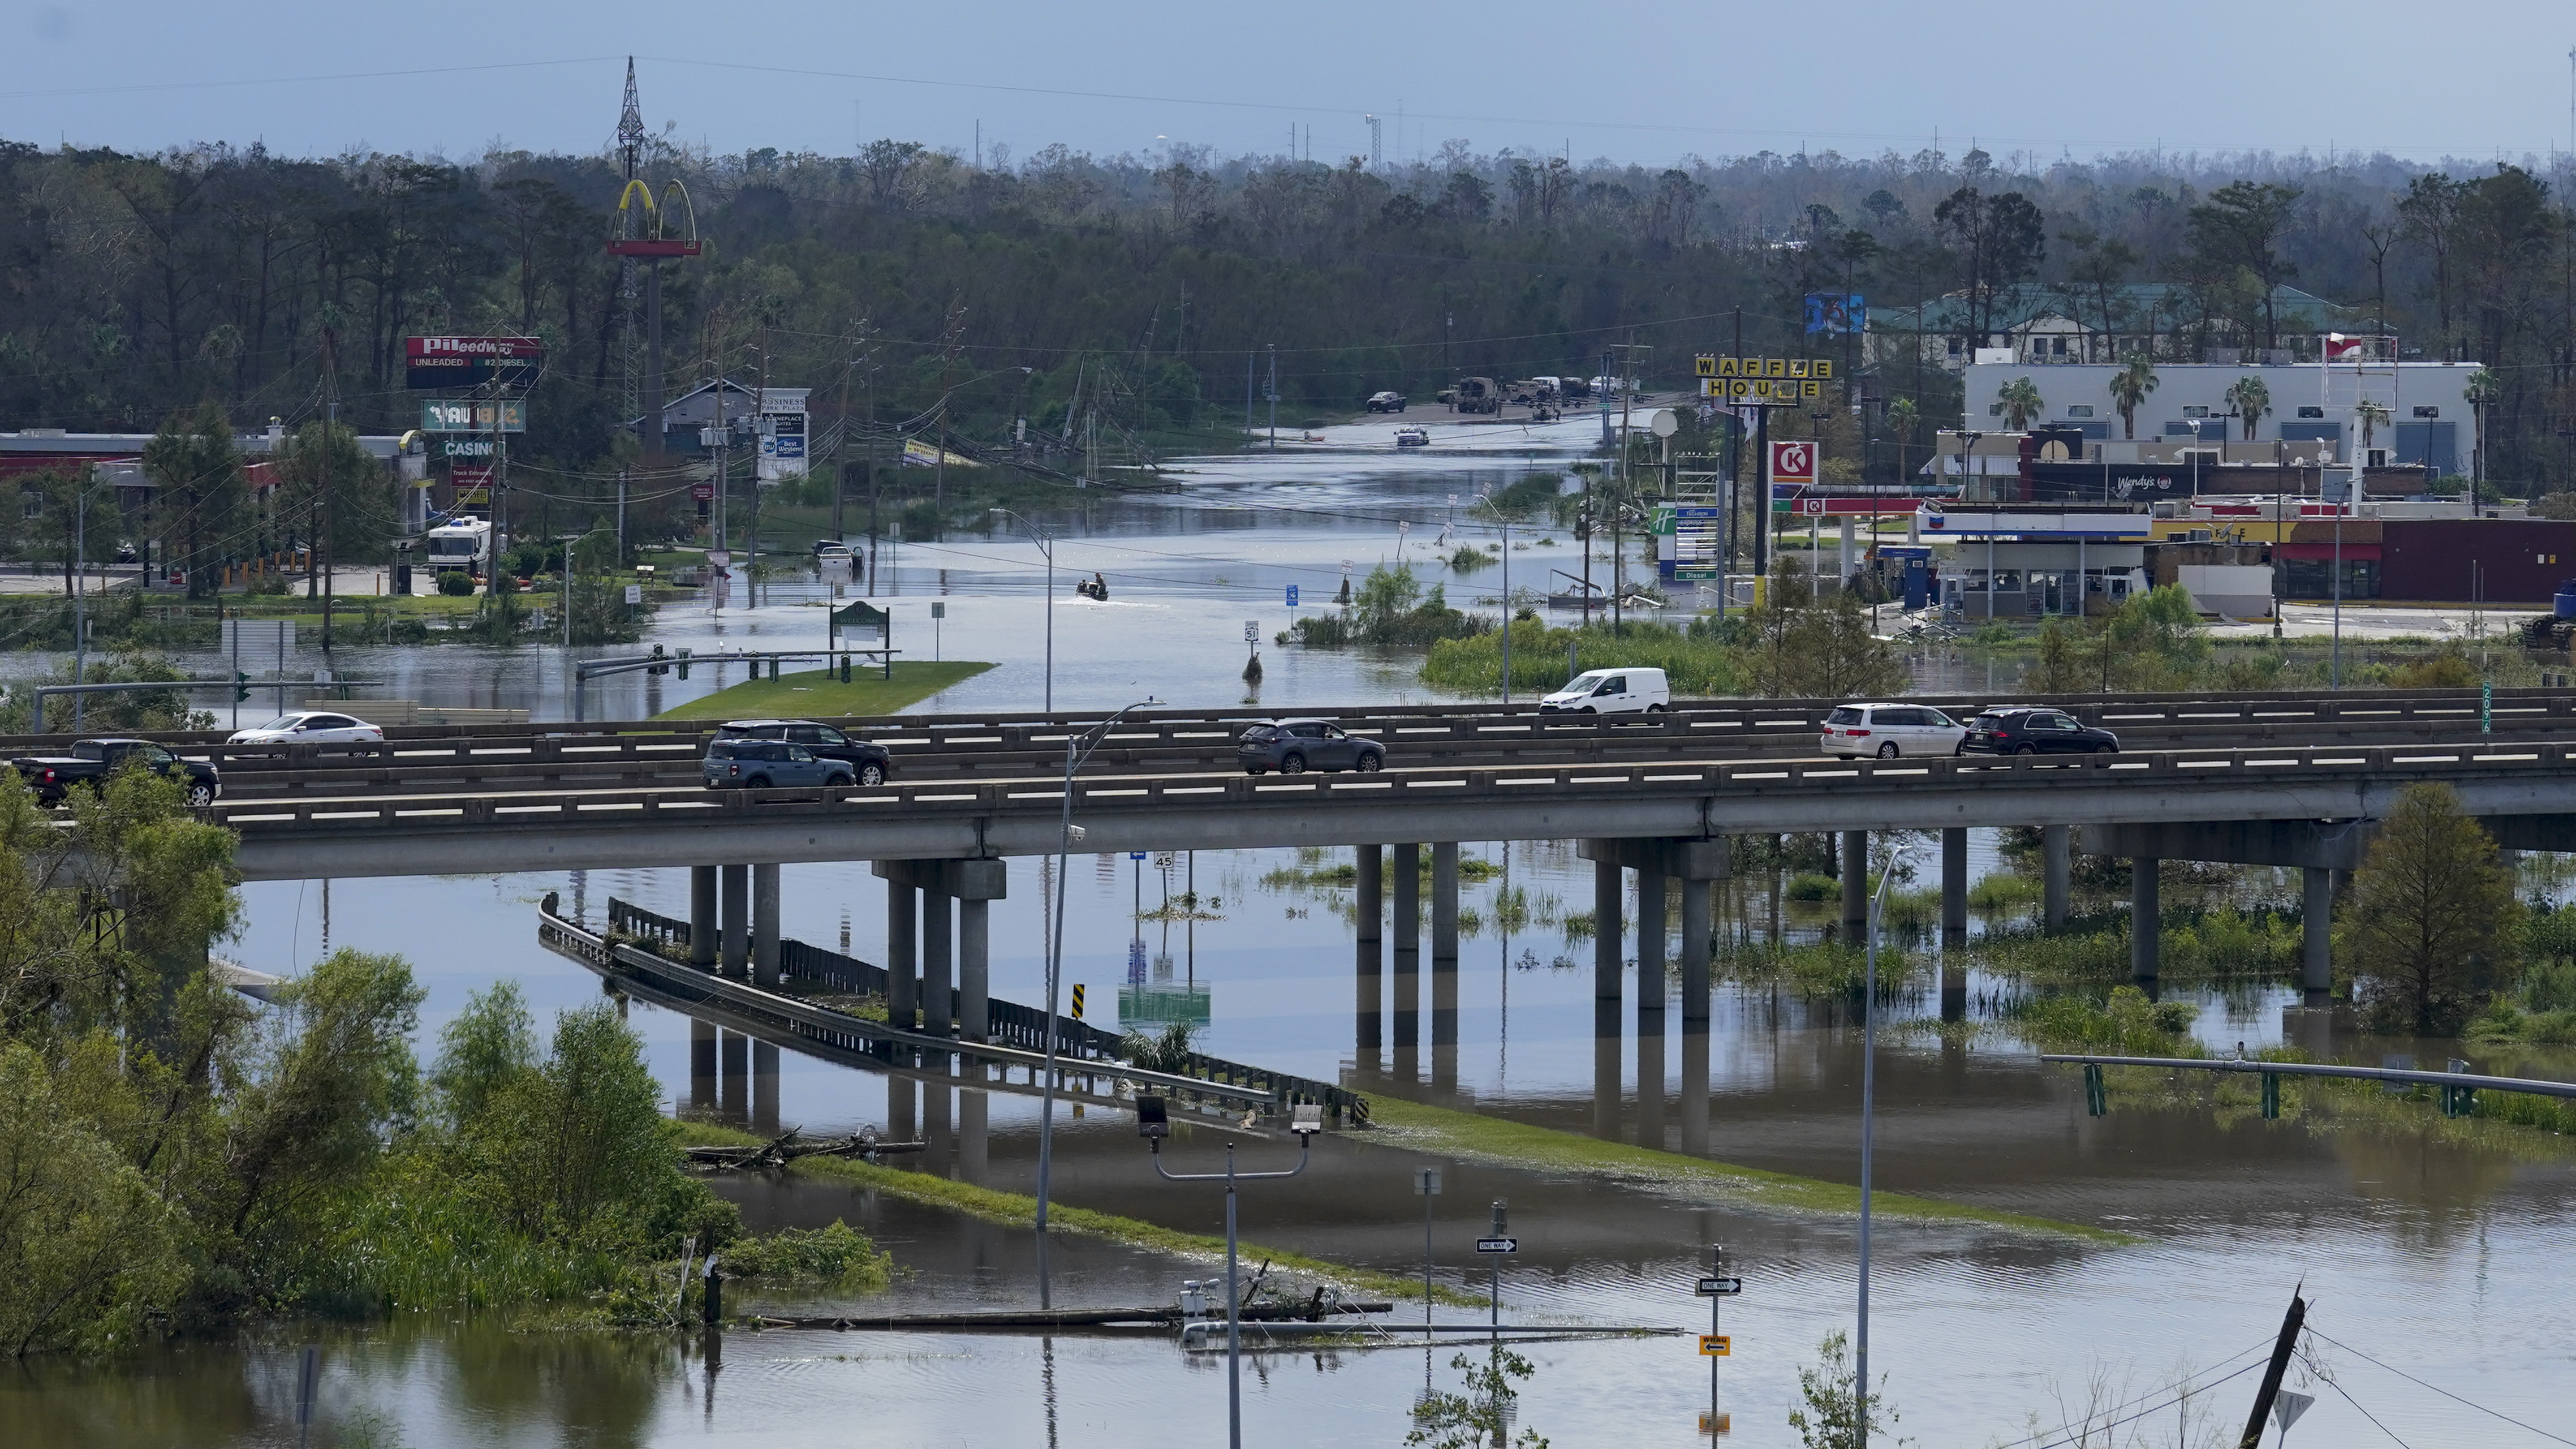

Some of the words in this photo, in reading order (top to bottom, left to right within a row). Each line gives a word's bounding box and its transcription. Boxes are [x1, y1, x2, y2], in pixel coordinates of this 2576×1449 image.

[416, 358, 463, 367] UNLEADED
[1699, 360, 1828, 376] WAFFE
[1711, 381, 1816, 396] HOUE
[2117, 474, 2155, 490] Wendy's
[1156, 857, 1172, 866] 45
